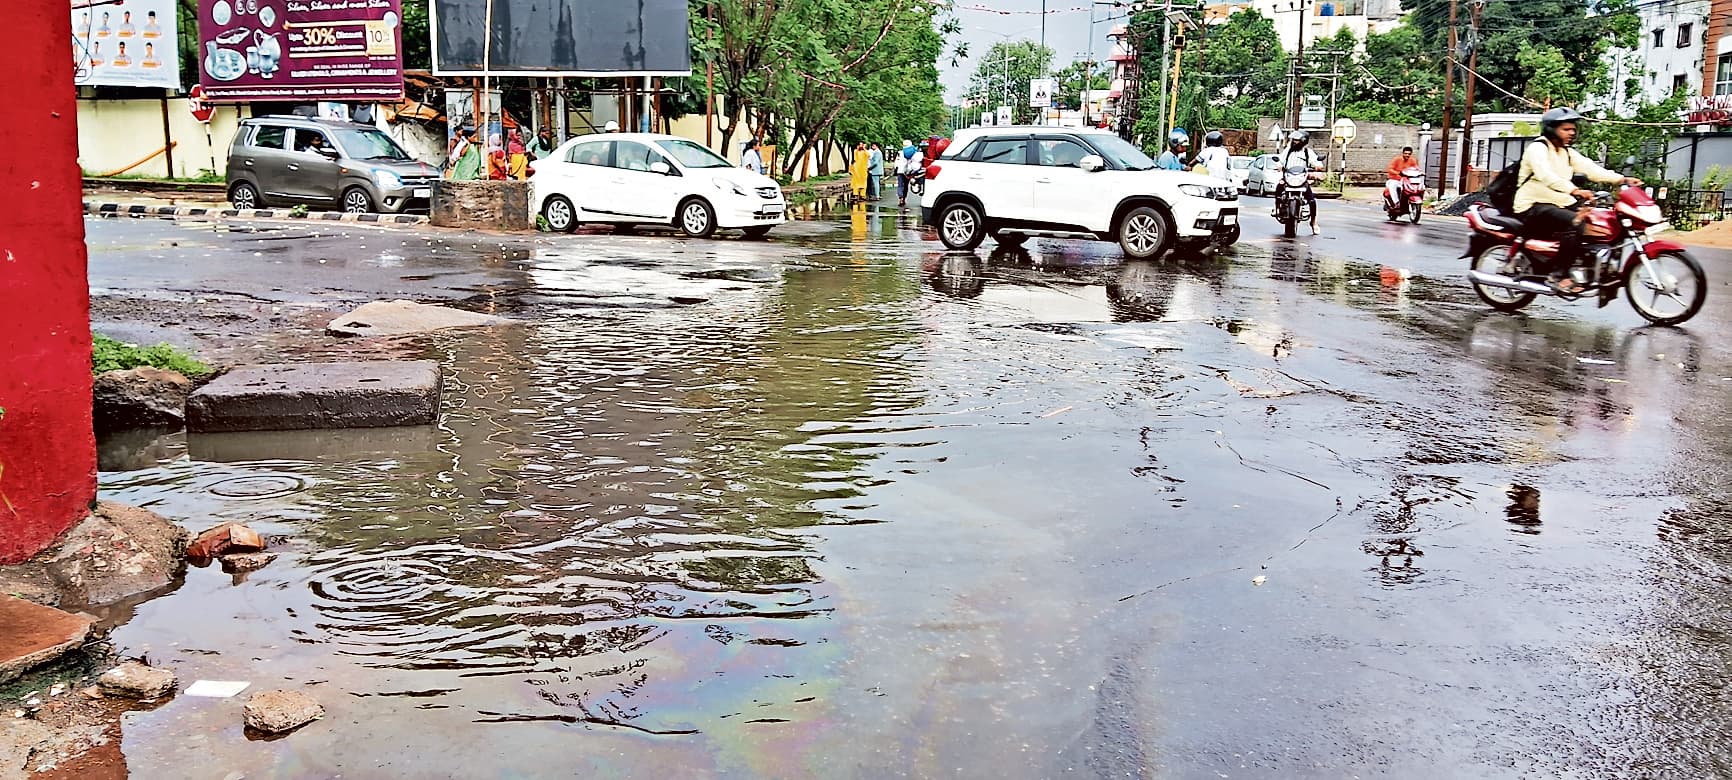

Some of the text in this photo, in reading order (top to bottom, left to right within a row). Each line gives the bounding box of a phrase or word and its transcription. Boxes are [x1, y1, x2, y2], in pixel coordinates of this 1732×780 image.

[310, 1, 331, 11] Silver
[332, 0, 348, 9] and
[368, 0, 391, 8] Silver
[303, 28, 336, 44] 30%
